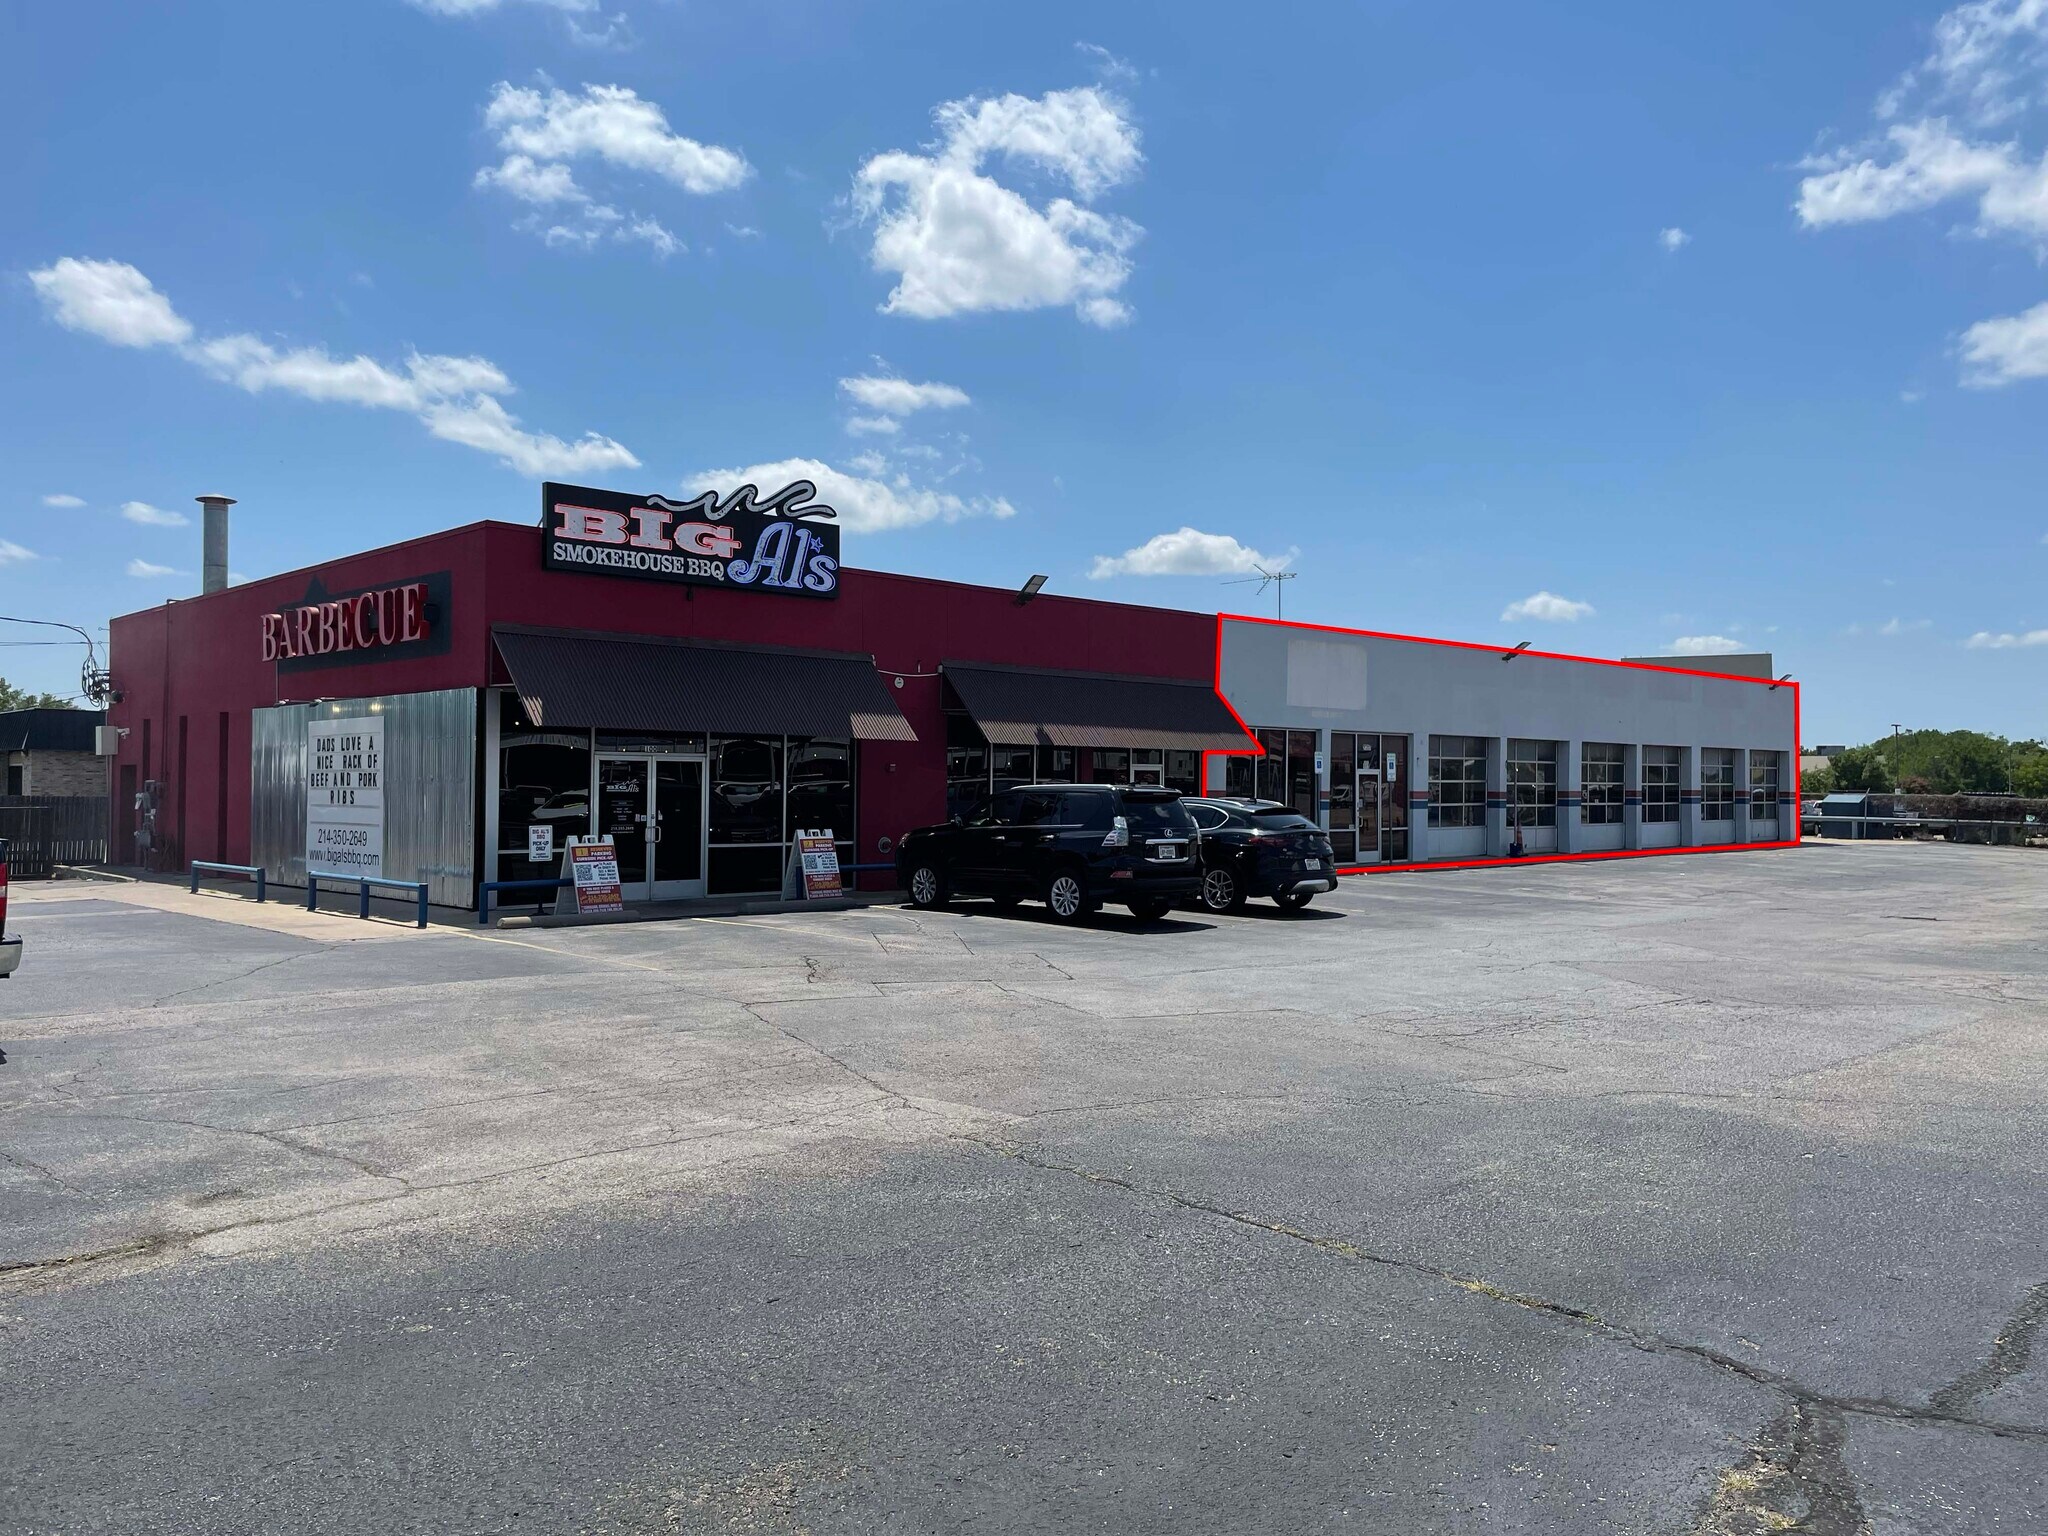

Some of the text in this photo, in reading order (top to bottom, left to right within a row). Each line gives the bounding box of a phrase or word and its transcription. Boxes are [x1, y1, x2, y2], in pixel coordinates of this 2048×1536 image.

[554, 503, 742, 558] BIG
[553, 541, 725, 581] SMOKEHOUSE BBQ
[261, 583, 430, 662] BARBECUE
[316, 736, 374, 752] DADS LOVE A
[316, 754, 377, 770] NICE RACK OF
[310, 772, 377, 787] BEEF AND PORK
[330, 790, 355, 804] RIBS
[317, 828, 367, 847] 214-350-2649
[309, 848, 380, 867] www.bigalsbbq.com
